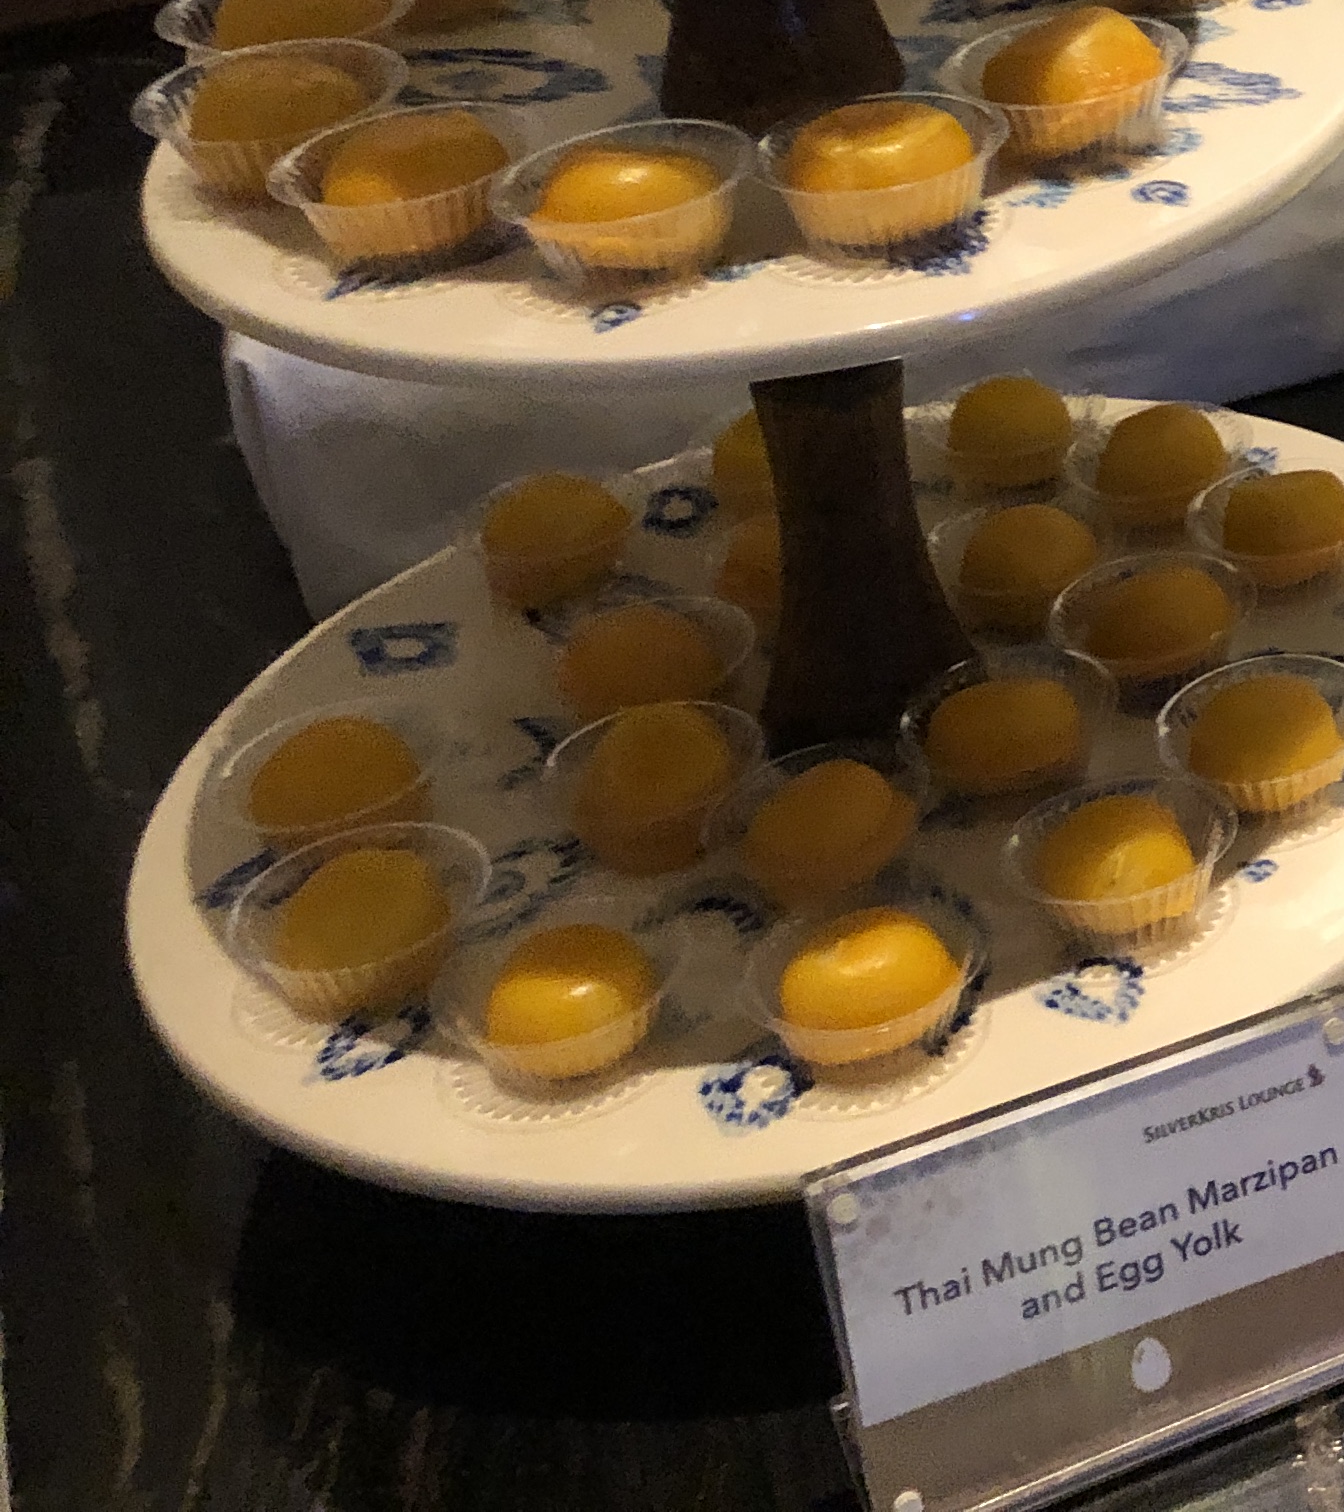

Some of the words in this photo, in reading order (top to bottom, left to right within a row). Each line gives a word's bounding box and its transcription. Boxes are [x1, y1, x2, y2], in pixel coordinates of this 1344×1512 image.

[1238, 1077, 1306, 1111] LOUNGE
[895, 1265, 972, 1317] Thai
[981, 1234, 1084, 1288] Mung
[1094, 1199, 1179, 1247] Bean
[1188, 1144, 1339, 1214] Marzipan
[1022, 1273, 1085, 1321] and
[1097, 1248, 1166, 1294] Egg
[1170, 1219, 1245, 1265] Yolk
